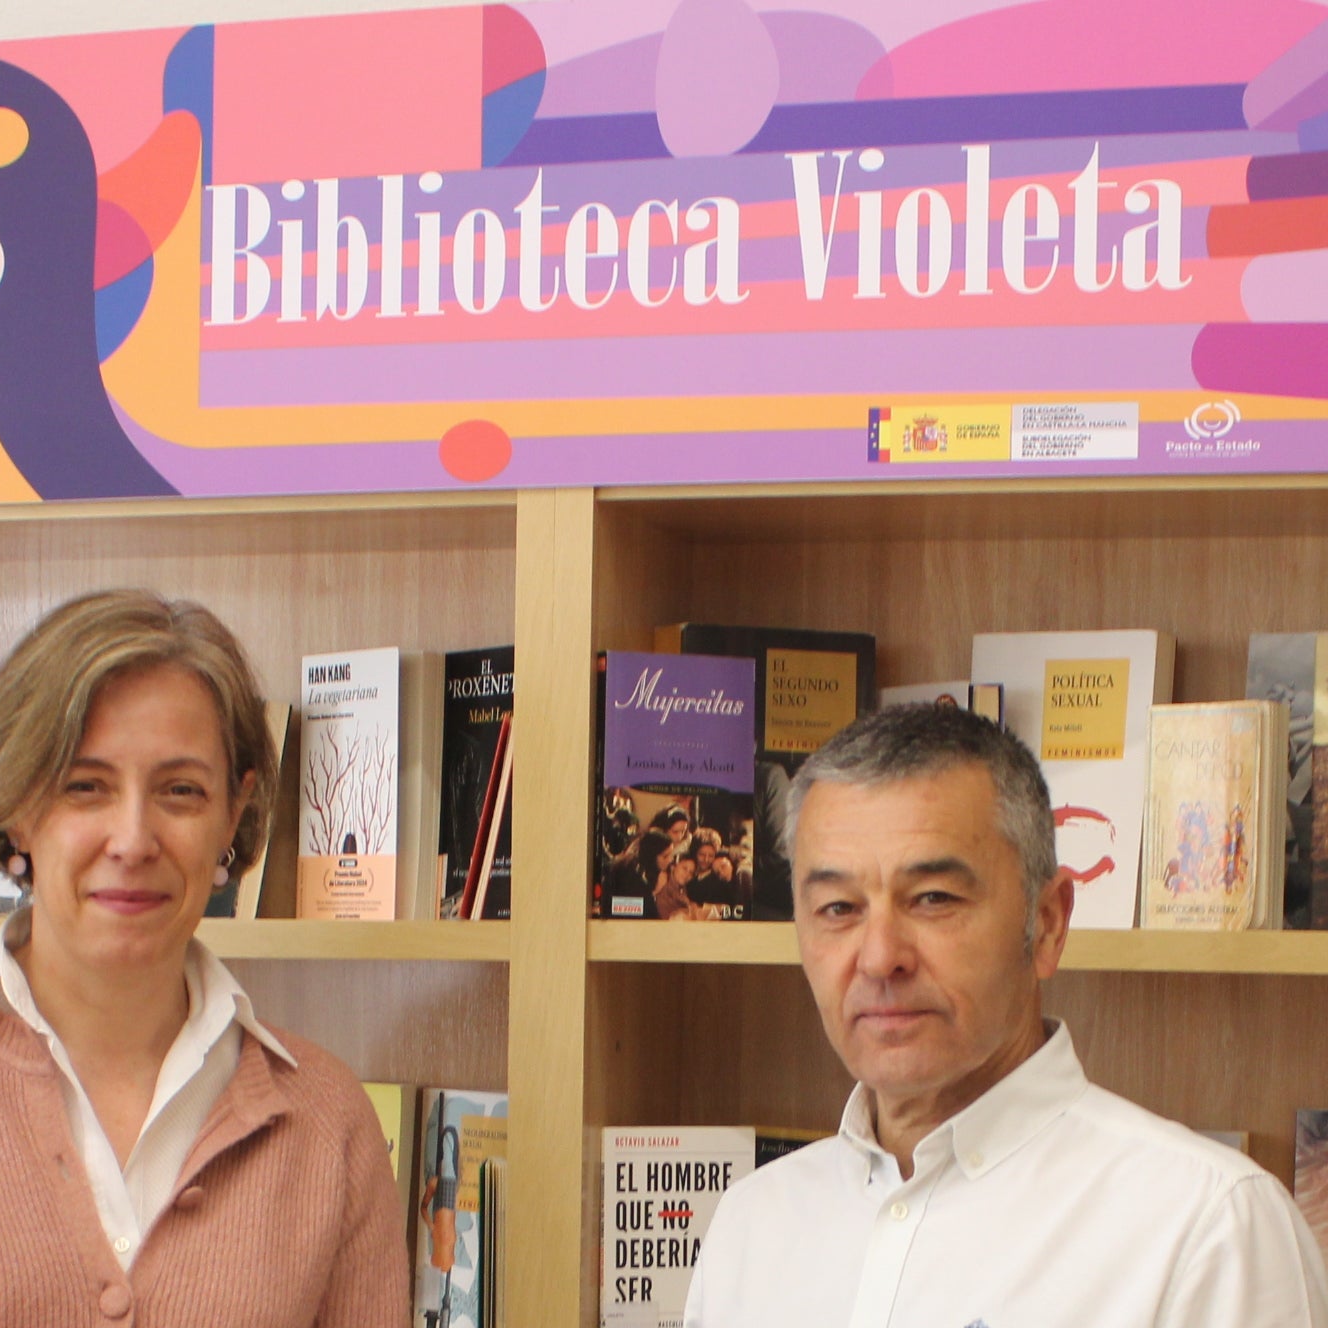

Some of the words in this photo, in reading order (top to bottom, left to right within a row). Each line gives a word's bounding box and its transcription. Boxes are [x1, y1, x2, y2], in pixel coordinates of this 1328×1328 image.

[203, 167, 750, 328] Biblioteca
[785, 140, 1192, 302] Violeta
[1166, 440, 1201, 452] Pacto
[1216, 439, 1261, 451] Estado
[308, 666, 326, 685] HAN
[328, 663, 351, 682] KANG
[481, 659, 493, 675] EL
[773, 659, 786, 673] EL
[772, 677, 839, 693] SEGUNDO
[1052, 671, 1114, 689] POLÍTICA
[308, 689, 321, 705] La
[323, 684, 378, 706] vegetariana
[614, 667, 745, 726] Mujercitas
[772, 692, 807, 707] SEXO
[1051, 693, 1103, 708] SEXUAL
[1048, 747, 1116, 757] FEMINISMOS
[626, 755, 666, 770] Louisa
[670, 756, 695, 774] May
[700, 756, 735, 774] Alcott
[615, 1137, 645, 1147] OCTAVIO
[648, 1137, 680, 1147] SALAZAR
[616, 1162, 638, 1192] EL
[647, 1162, 733, 1192] HOMBRE
[615, 1200, 654, 1233] QUE
[663, 1200, 690, 1230] NO
[615, 1231, 701, 1269] DEBERÍA
